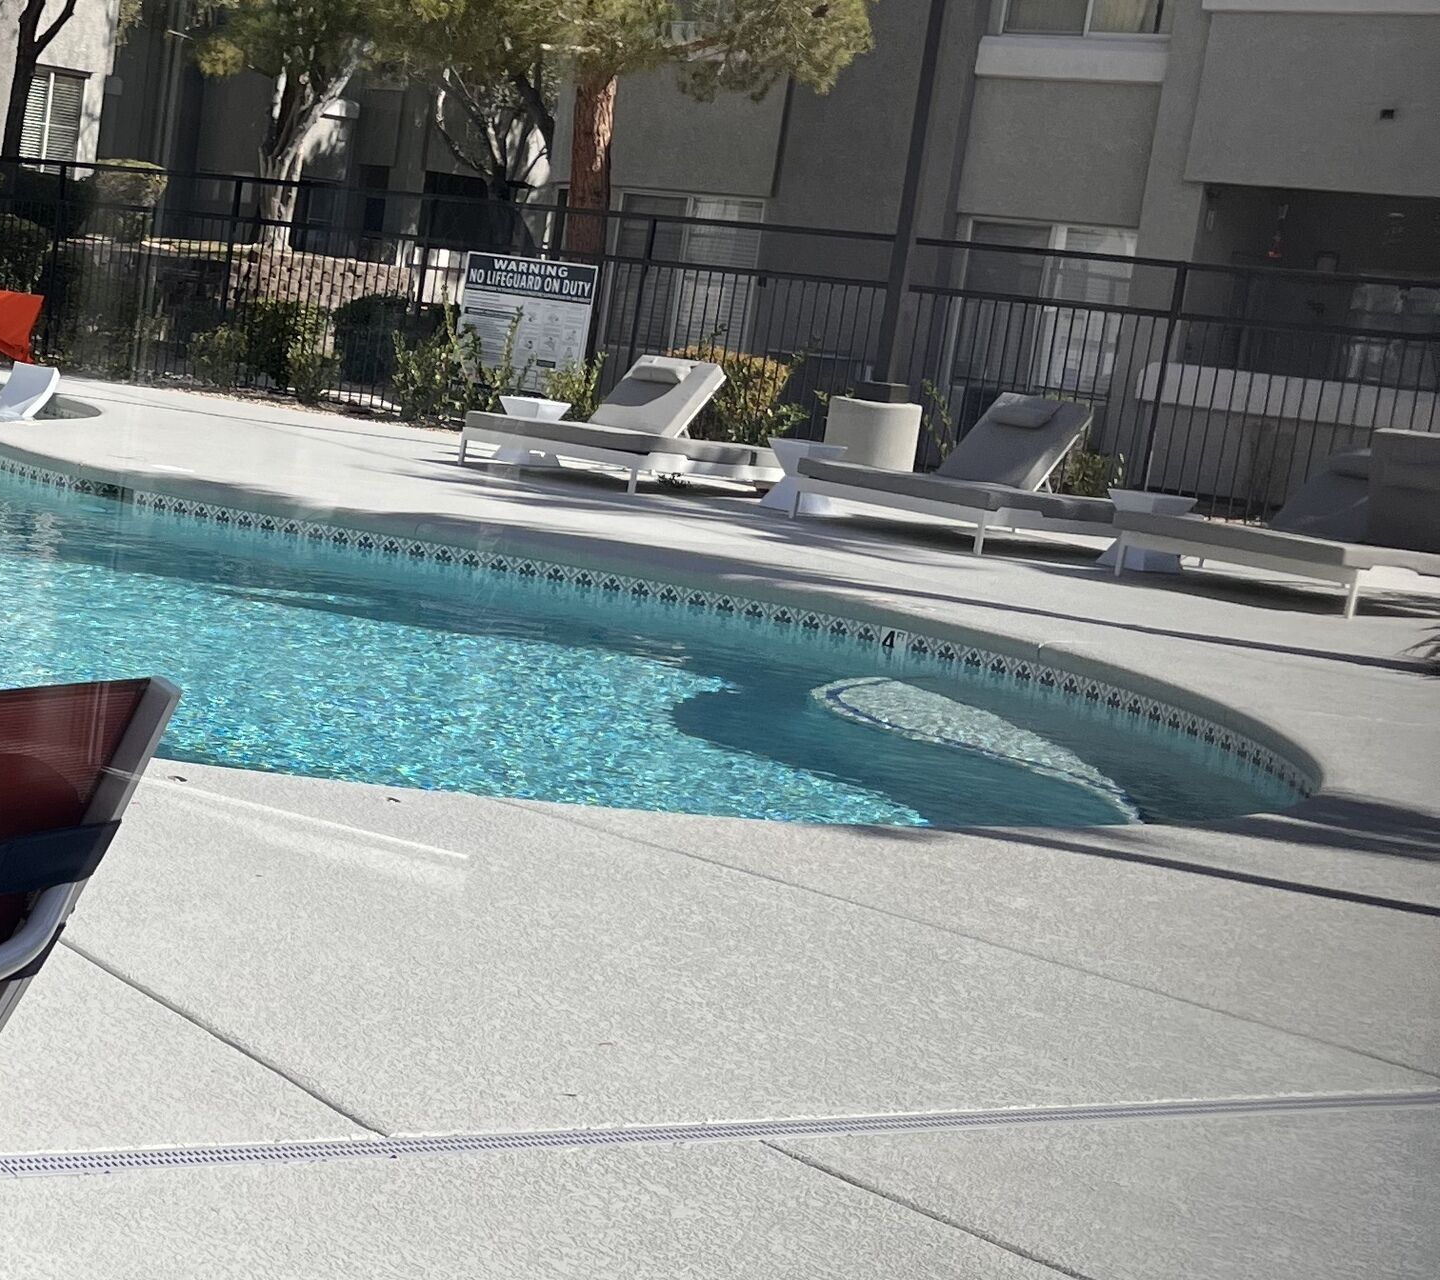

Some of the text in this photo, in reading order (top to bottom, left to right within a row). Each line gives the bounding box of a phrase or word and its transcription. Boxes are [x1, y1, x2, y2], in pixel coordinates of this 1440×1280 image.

[493, 258, 569, 278] WARNING
[468, 268, 485, 283] NO
[486, 270, 542, 291] LIFEGUARD
[543, 277, 561, 294] ON
[562, 279, 592, 297] DUTY
[881, 630, 896, 648] 4
